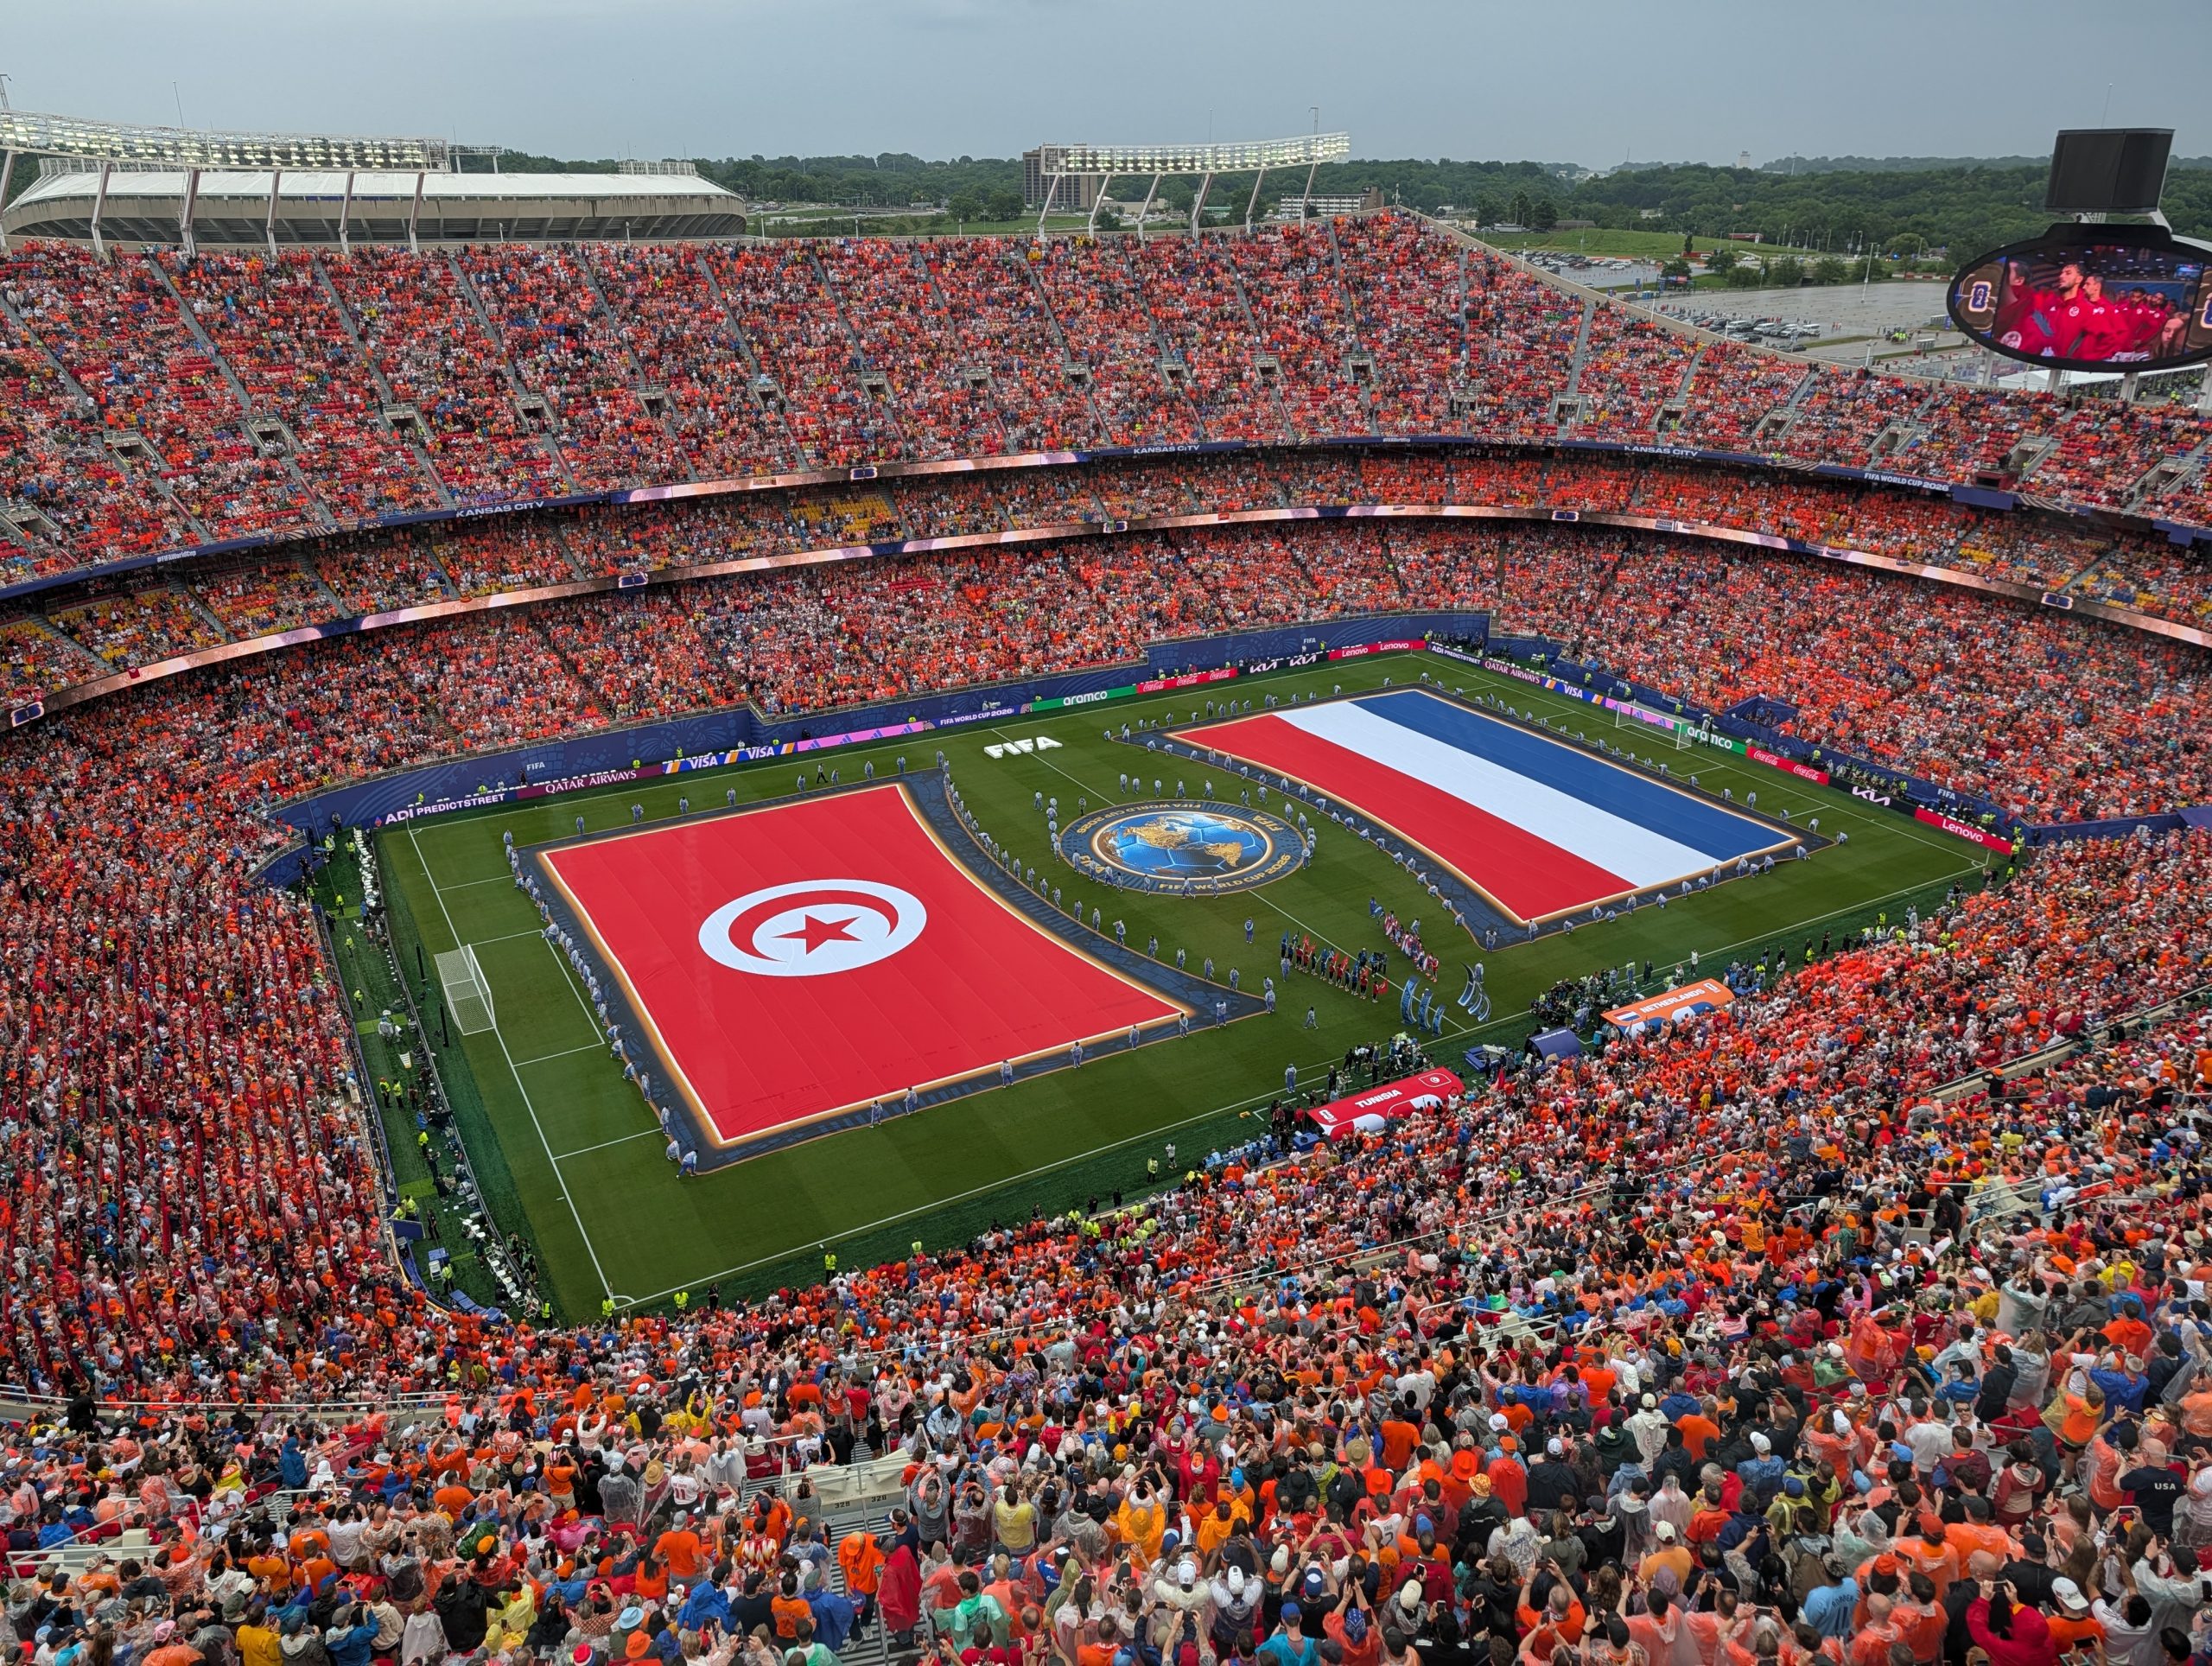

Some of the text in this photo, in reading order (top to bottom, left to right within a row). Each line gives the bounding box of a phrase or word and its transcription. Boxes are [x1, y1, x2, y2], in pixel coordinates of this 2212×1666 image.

[1133, 443, 1201, 455] KANSAS CITY
[1624, 445, 1699, 458] KANSAS CITY
[1864, 472, 1950, 493] FIFA WORLD CUP 2026
[455, 500, 544, 518] KANSAS CITY
[156, 550, 197, 563] #FIFAWorldCup
[1341, 646, 1369, 658] Lenovo
[1380, 640, 1409, 652] Lenovo
[1289, 654, 1318, 667] KIA
[1431, 645, 1481, 665] ADI PREDICTSTREET
[1249, 659, 1279, 674] KIA
[1484, 660, 1541, 684] QATAR AIRWAYS
[1063, 690, 1108, 706] aramco
[1563, 684, 1584, 699] VISA
[940, 707, 1012, 726] FIFA WORLD CUP 2026
[1687, 726, 1732, 750] aramco
[747, 747, 775, 760] VISA
[983, 735, 1063, 760] FIFA
[526, 761, 545, 772] FIFA
[689, 755, 719, 769] VISA
[545, 769, 637, 794] QATAR AIRWAYS
[1852, 785, 1891, 806] KIA
[1937, 787, 1956, 801] FIFA
[385, 792, 505, 825] ADI PREDICTSTREET
[1252, 815, 1285, 832] FIFA
[1942, 818, 1984, 843] Lenovo
[1243, 872, 1266, 883] CUP
[1265, 854, 1292, 874] 2026
[1639, 988, 1706, 1014] NETHERLANDS
[1355, 1090, 1403, 1109] TUNISIA
[2154, 1482, 2176, 1491] USA
